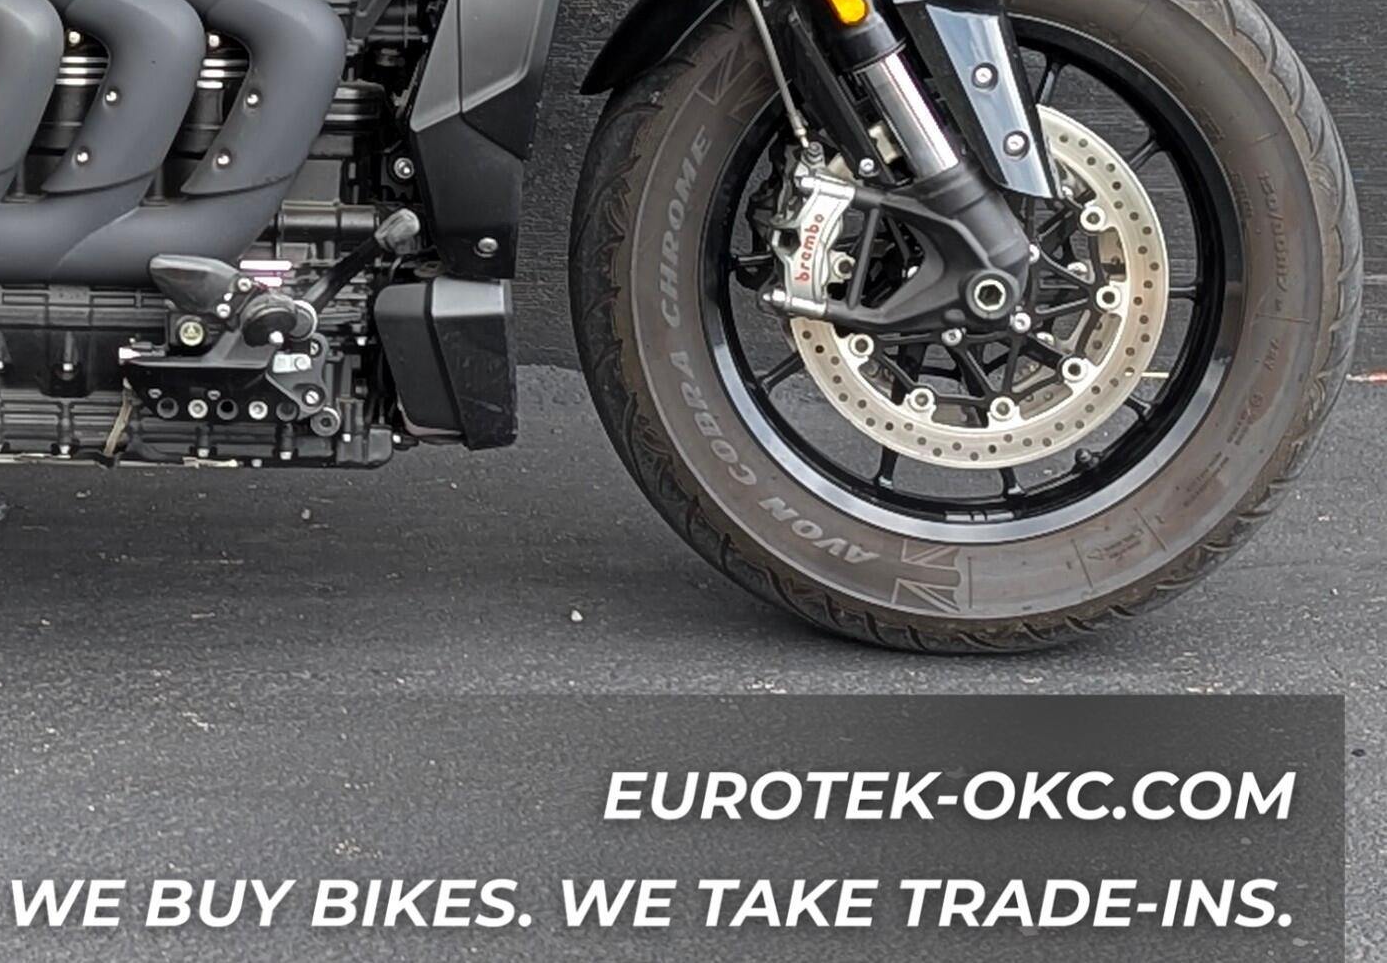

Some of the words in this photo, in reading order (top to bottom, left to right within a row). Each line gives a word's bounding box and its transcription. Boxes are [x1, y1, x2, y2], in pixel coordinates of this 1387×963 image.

[656, 124, 712, 329] CHROME
[795, 213, 825, 282] brembo
[668, 349, 758, 487] COBRA
[757, 495, 880, 566] AVON
